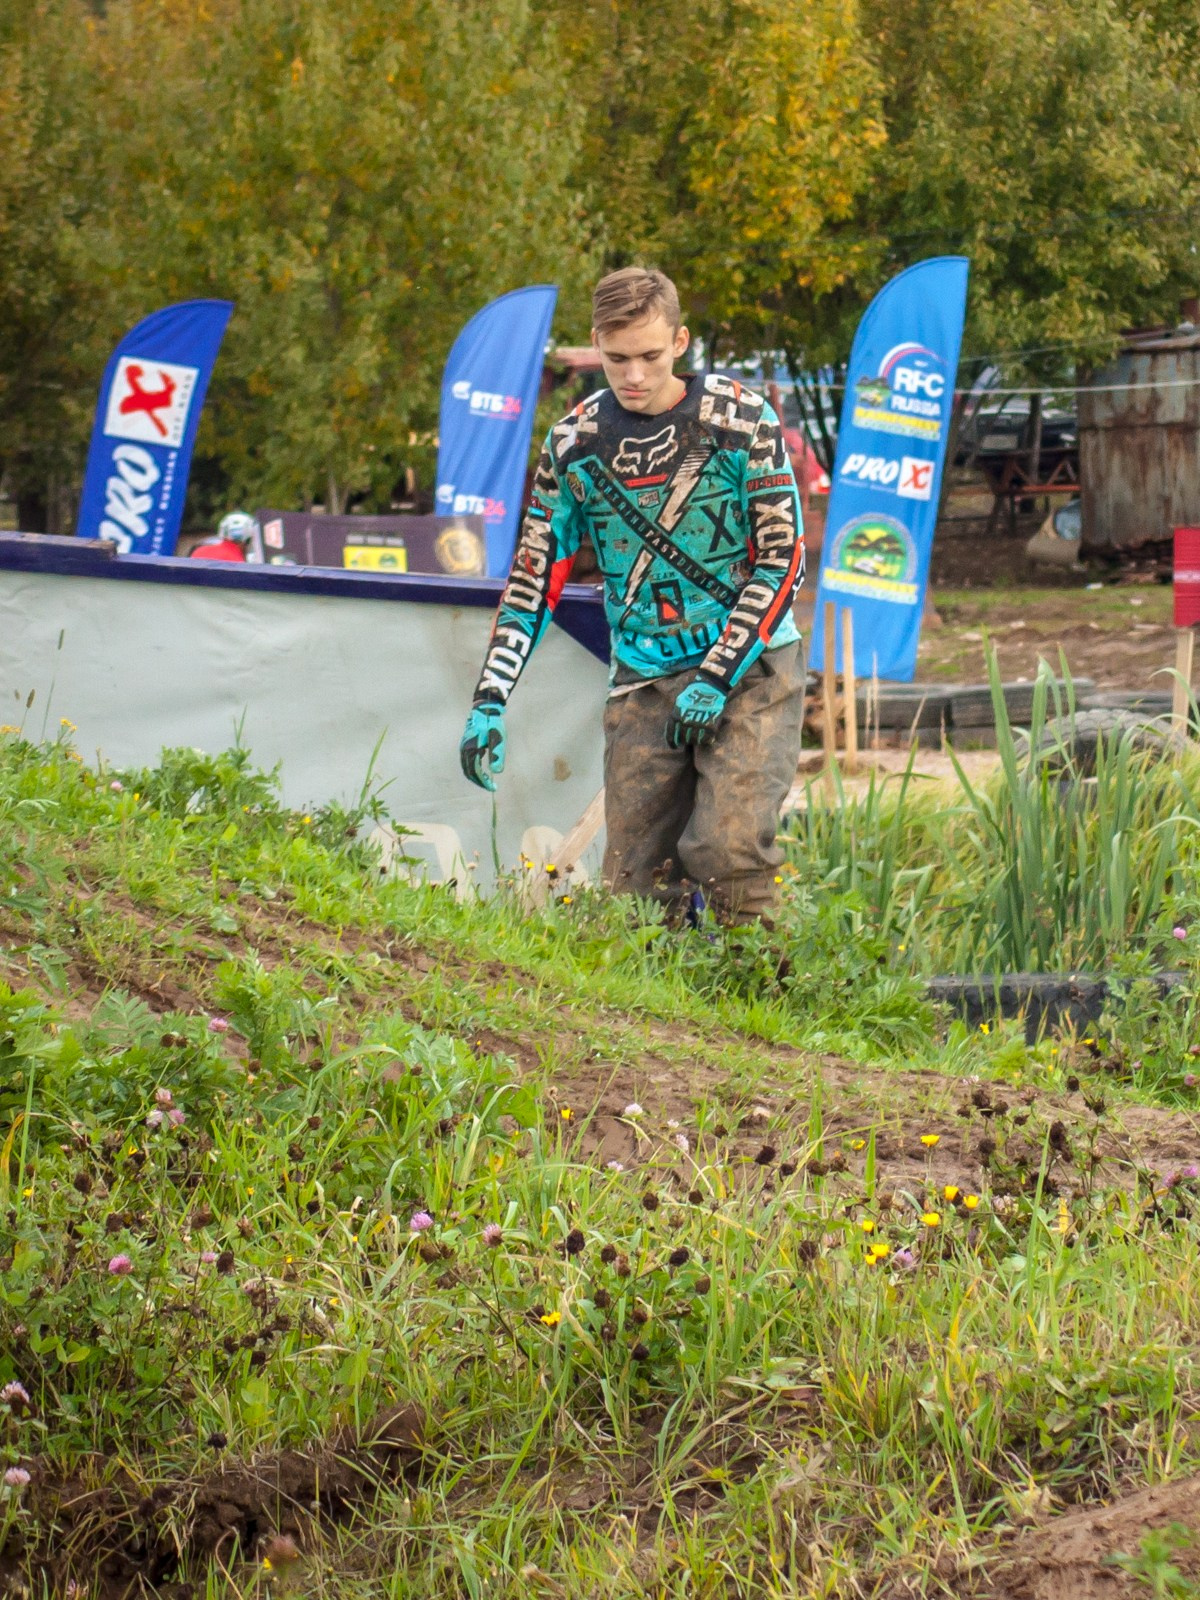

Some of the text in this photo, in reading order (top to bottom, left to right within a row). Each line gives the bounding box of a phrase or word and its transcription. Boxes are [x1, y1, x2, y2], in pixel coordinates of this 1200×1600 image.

[893, 367, 945, 398] RFC
[841, 453, 900, 485] PRO
[902, 464, 931, 490] X
[755, 496, 794, 568] FOX
[479, 628, 532, 701] FOX
